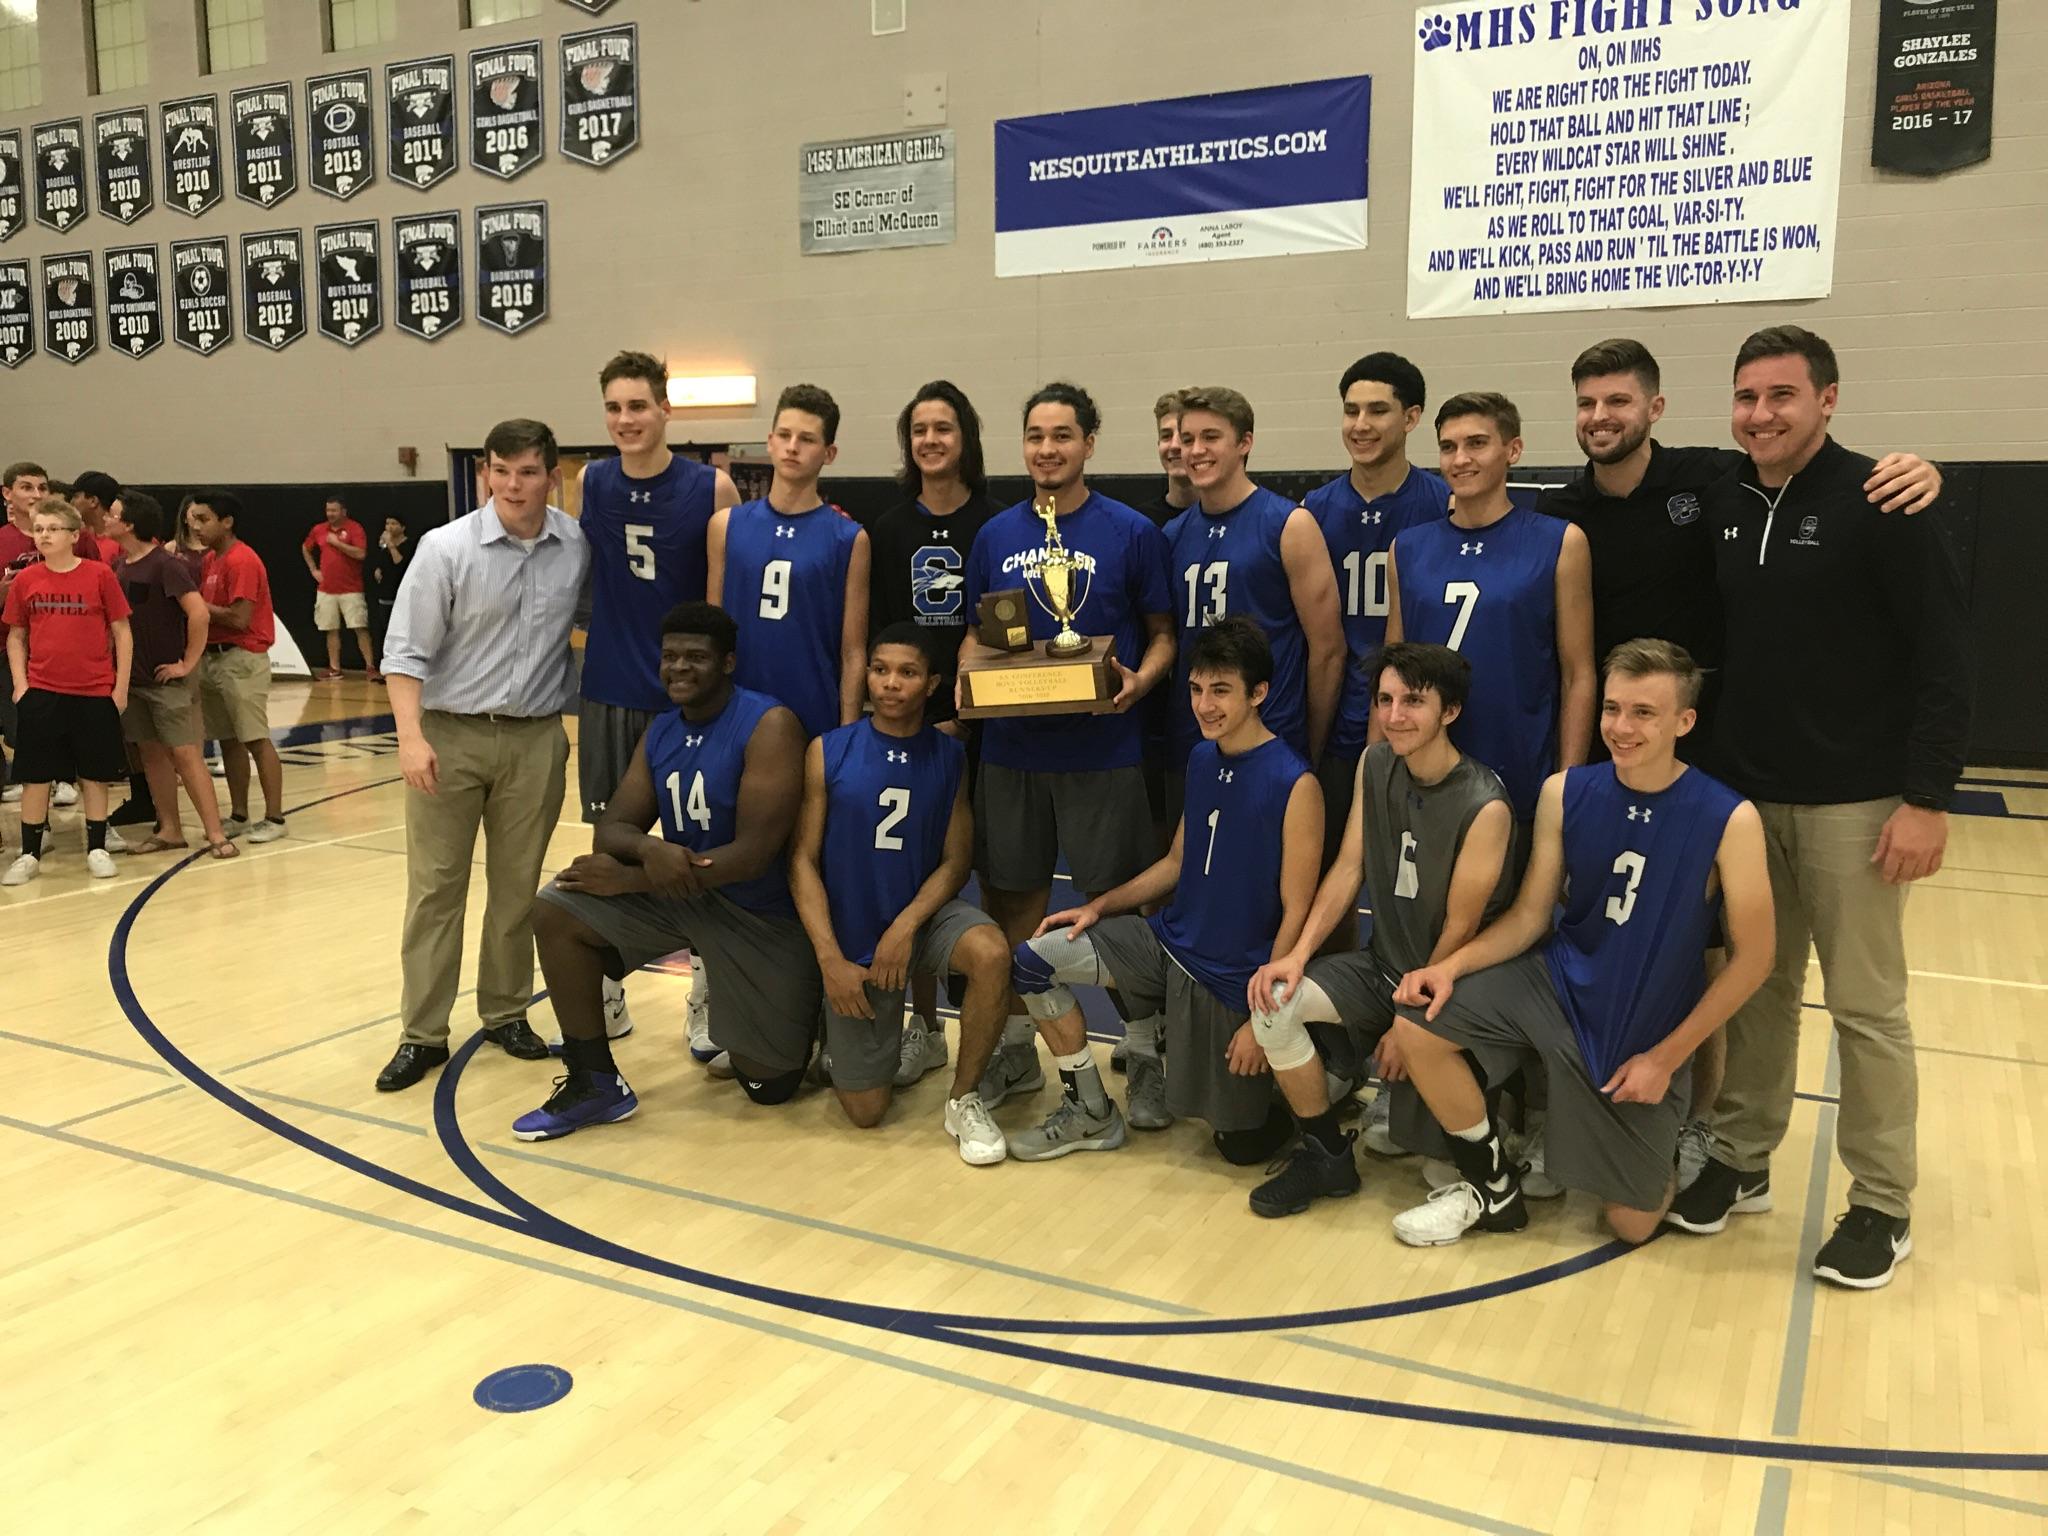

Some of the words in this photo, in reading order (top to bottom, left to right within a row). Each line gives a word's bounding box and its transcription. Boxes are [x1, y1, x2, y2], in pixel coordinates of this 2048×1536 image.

[1456, 4, 1535, 51] MHS
[1549, 0, 1672, 40] FIGHT
[565, 42, 598, 72] FINAL
[601, 38, 630, 62] FOUR
[1578, 45, 1601, 74] ON,
[1607, 42, 1626, 67] ON
[1631, 37, 1661, 63] MHS
[1902, 34, 1970, 52] SHAYLEE
[475, 57, 506, 85] FINAL
[508, 54, 536, 77] FOUR
[1894, 49, 1977, 68] GONZALES
[311, 84, 339, 111] FINAL
[341, 81, 366, 103] FOUR
[391, 72, 420, 98] FINAL
[423, 67, 448, 92] FOUR
[1493, 90, 1512, 113] WE
[1515, 86, 1542, 111] ARE
[1546, 81, 1588, 108] RIGHT
[1592, 77, 1618, 103] FOR
[1624, 73, 1650, 98] THE
[1655, 67, 1698, 95] FIGHT
[1703, 60, 1751, 89] TODAY.
[165, 108, 189, 134] FINAL
[192, 105, 213, 127] FOUR
[236, 97, 261, 123] FINAL
[263, 94, 287, 115] FOUR
[1893, 113, 1932, 129] 2016
[1953, 110, 1972, 124] 17
[99, 119, 121, 144] FINAL
[123, 118, 144, 137] FOUR
[404, 123, 442, 139] BASEBALL
[579, 113, 622, 141] 2017
[1491, 122, 1525, 146] HOLD
[1530, 117, 1564, 142] THAT
[1568, 113, 1600, 138] BALL
[1606, 109, 1634, 135] AND
[1639, 106, 1662, 131] HIT
[1668, 102, 1704, 128] THAT
[37, 130, 58, 154] FINAL
[59, 129, 79, 148] FOUR
[247, 145, 282, 161] BASEBALL
[323, 135, 360, 151] FOOTBALL
[404, 138, 442, 165] 2014
[485, 126, 528, 153] 2016
[173, 156, 210, 171] WRESTLING
[324, 149, 362, 176] 2013
[807, 149, 833, 173] 1455
[836, 141, 902, 170] AMERICAN
[905, 135, 944, 162] GRILL
[1029, 129, 1327, 182] MESQUITEATHLETICS.COM
[1496, 151, 1538, 176] EVERY
[1543, 144, 1601, 171] WILDCAT
[1605, 141, 1640, 166] STAR
[1645, 137, 1677, 162] WILL
[108, 165, 139, 179] BASEBALL
[176, 169, 209, 194] 2010
[247, 159, 282, 184] 2011
[1444, 185, 1479, 209] WE'LL
[1484, 183, 1524, 209] FIGHT,
[1529, 180, 1570, 206] FIGHT,
[1574, 176, 1615, 201] FIGHT
[1619, 174, 1646, 198] FOR
[1651, 172, 1678, 196] THE
[1683, 165, 1733, 194] SILVER
[1738, 161, 1768, 187] AND
[1773, 156, 1812, 184] BLUE
[46, 188, 77, 210] 2008
[109, 179, 140, 202] 2010
[834, 191, 850, 209] SE
[855, 190, 896, 207] Corner
[902, 185, 913, 202] of
[481, 215, 511, 240] FINAL
[513, 212, 541, 236] FOUR
[815, 218, 847, 237] Elliot
[852, 216, 874, 234] and
[879, 212, 939, 231] McQueen
[1200, 224, 1219, 232] ANNA
[1488, 217, 1504, 239] AS
[1508, 215, 1527, 238] WE
[1531, 212, 1564, 236] ROLL
[1568, 210, 1585, 234] TO
[1590, 207, 1624, 232] THAT
[1628, 204, 1669, 231] GOAL,
[321, 235, 348, 257] FINAL
[350, 232, 374, 253] FOUR
[400, 225, 427, 250] FINAL
[429, 223, 454, 245] FOUR
[1119, 241, 1126, 249] BY
[1138, 239, 1187, 249] FARMERS
[1428, 250, 1454, 272] AND
[1459, 248, 1494, 270] WE'LL
[1499, 245, 1534, 270] KICK,
[1539, 242, 1570, 265] PASS
[1575, 239, 1602, 263] AND
[1608, 237, 1635, 261] RUN
[1673, 233, 1700, 256] THE
[1705, 228, 1759, 254] BATTLE
[1764, 227, 1777, 251] IS
[1783, 224, 1820, 253] WON,
[109, 255, 131, 278] FINAL
[133, 253, 154, 274] FOUR
[176, 249, 200, 271] FINAL
[202, 247, 223, 268] FOUR
[247, 242, 272, 266] FINAL
[274, 239, 297, 260] FOUR
[46, 263, 68, 285] FINAL
[69, 261, 89, 281] FOUR
[410, 276, 447, 290] BASEBALL
[1474, 277, 1499, 300] AND
[1505, 274, 1541, 298] WE'LL
[1546, 271, 1587, 295] BRING
[1591, 268, 1630, 292] HOME
[1635, 265, 1661, 289] THE
[257, 290, 292, 303] BASEBALL
[411, 291, 449, 315] 2015
[491, 283, 533, 308] 2016
[188, 310, 220, 331] 2011
[258, 304, 293, 326] 2012
[332, 298, 368, 321] 2014
[56, 320, 87, 341] 2008
[119, 315, 149, 335] 2010
[625, 524, 656, 580] 5
[759, 560, 791, 620] 9
[1184, 561, 1228, 627] 13
[1343, 551, 1389, 616] 10
[1444, 582, 1479, 651] 7
[666, 770, 711, 831] 14
[875, 788, 910, 850] 2
[1204, 809, 1220, 875] 1
[1605, 851, 1645, 926] 3
